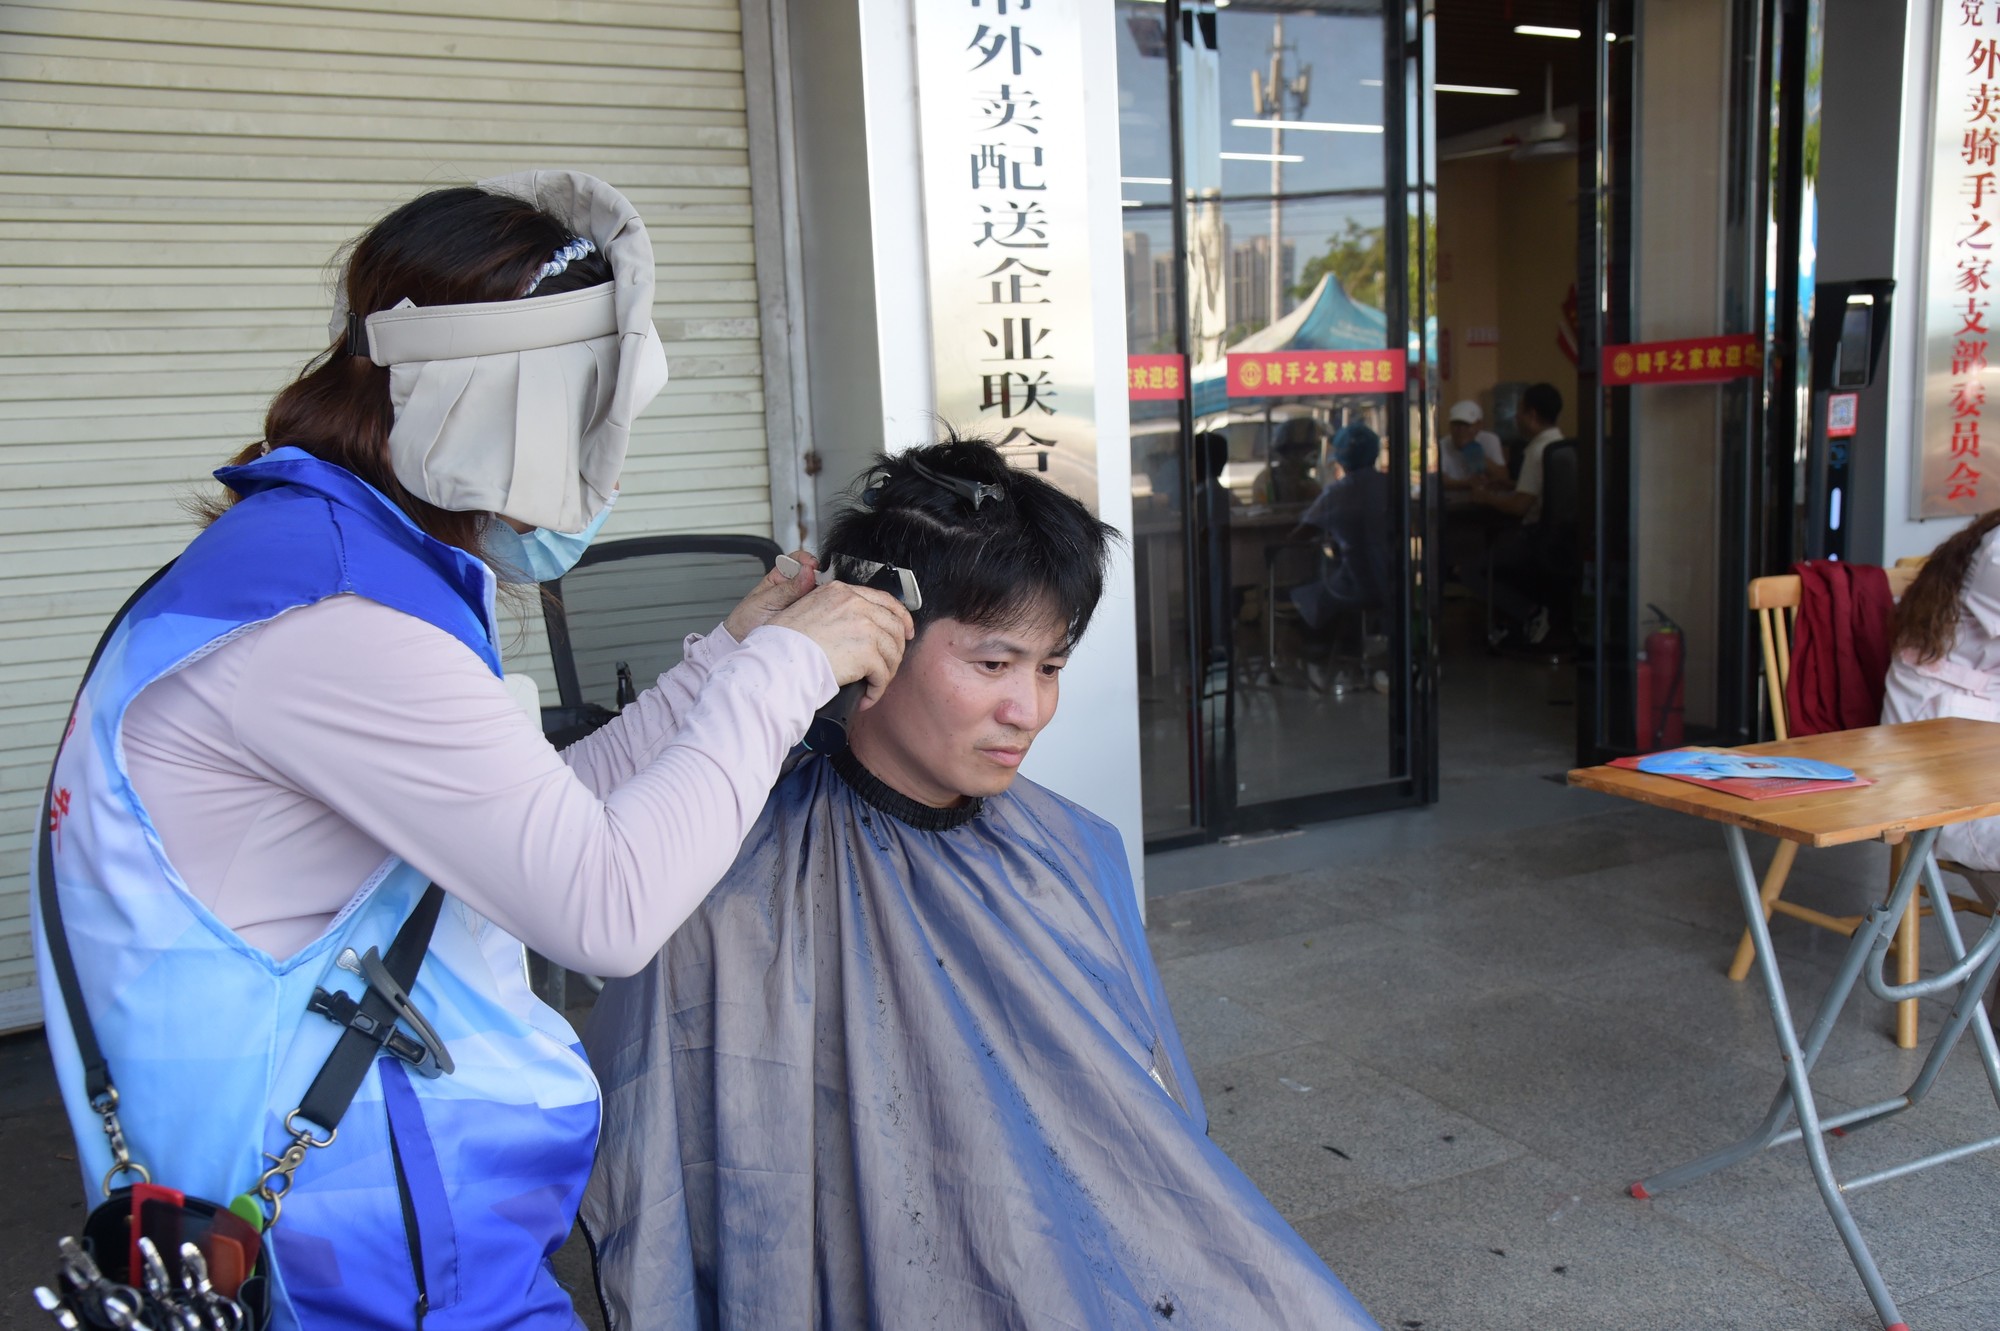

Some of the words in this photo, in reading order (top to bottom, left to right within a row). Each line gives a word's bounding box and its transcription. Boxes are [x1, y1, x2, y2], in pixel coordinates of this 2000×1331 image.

[965, 0, 1058, 473] 外卖配送企业联合
[1266, 360, 1393, 386] 骑手之家欢迎您
[1944, 37, 2000, 501] 外卖骑手之家支部委员会
